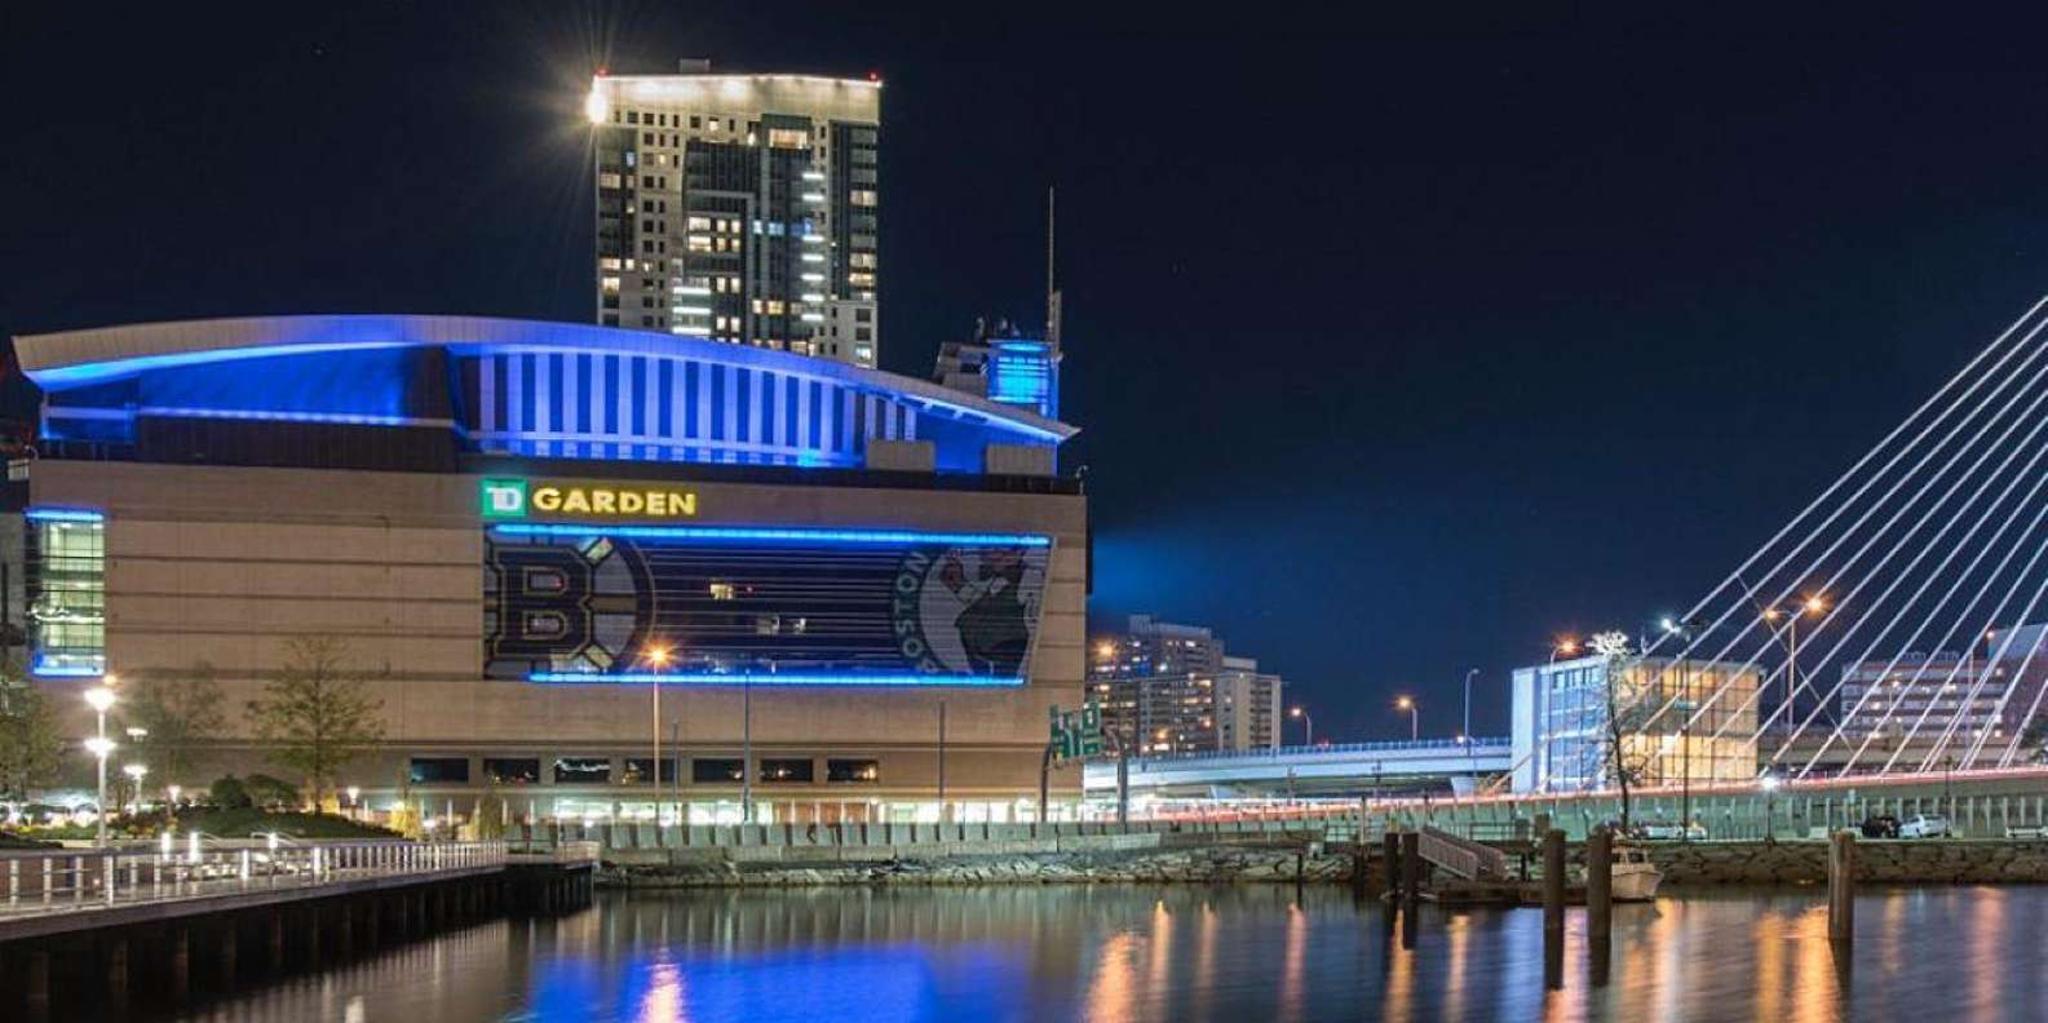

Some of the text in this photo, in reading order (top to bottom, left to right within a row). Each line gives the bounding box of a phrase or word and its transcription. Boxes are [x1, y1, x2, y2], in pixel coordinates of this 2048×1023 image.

[486, 487, 696, 515] TD GARDEN
[494, 545, 592, 659] B
